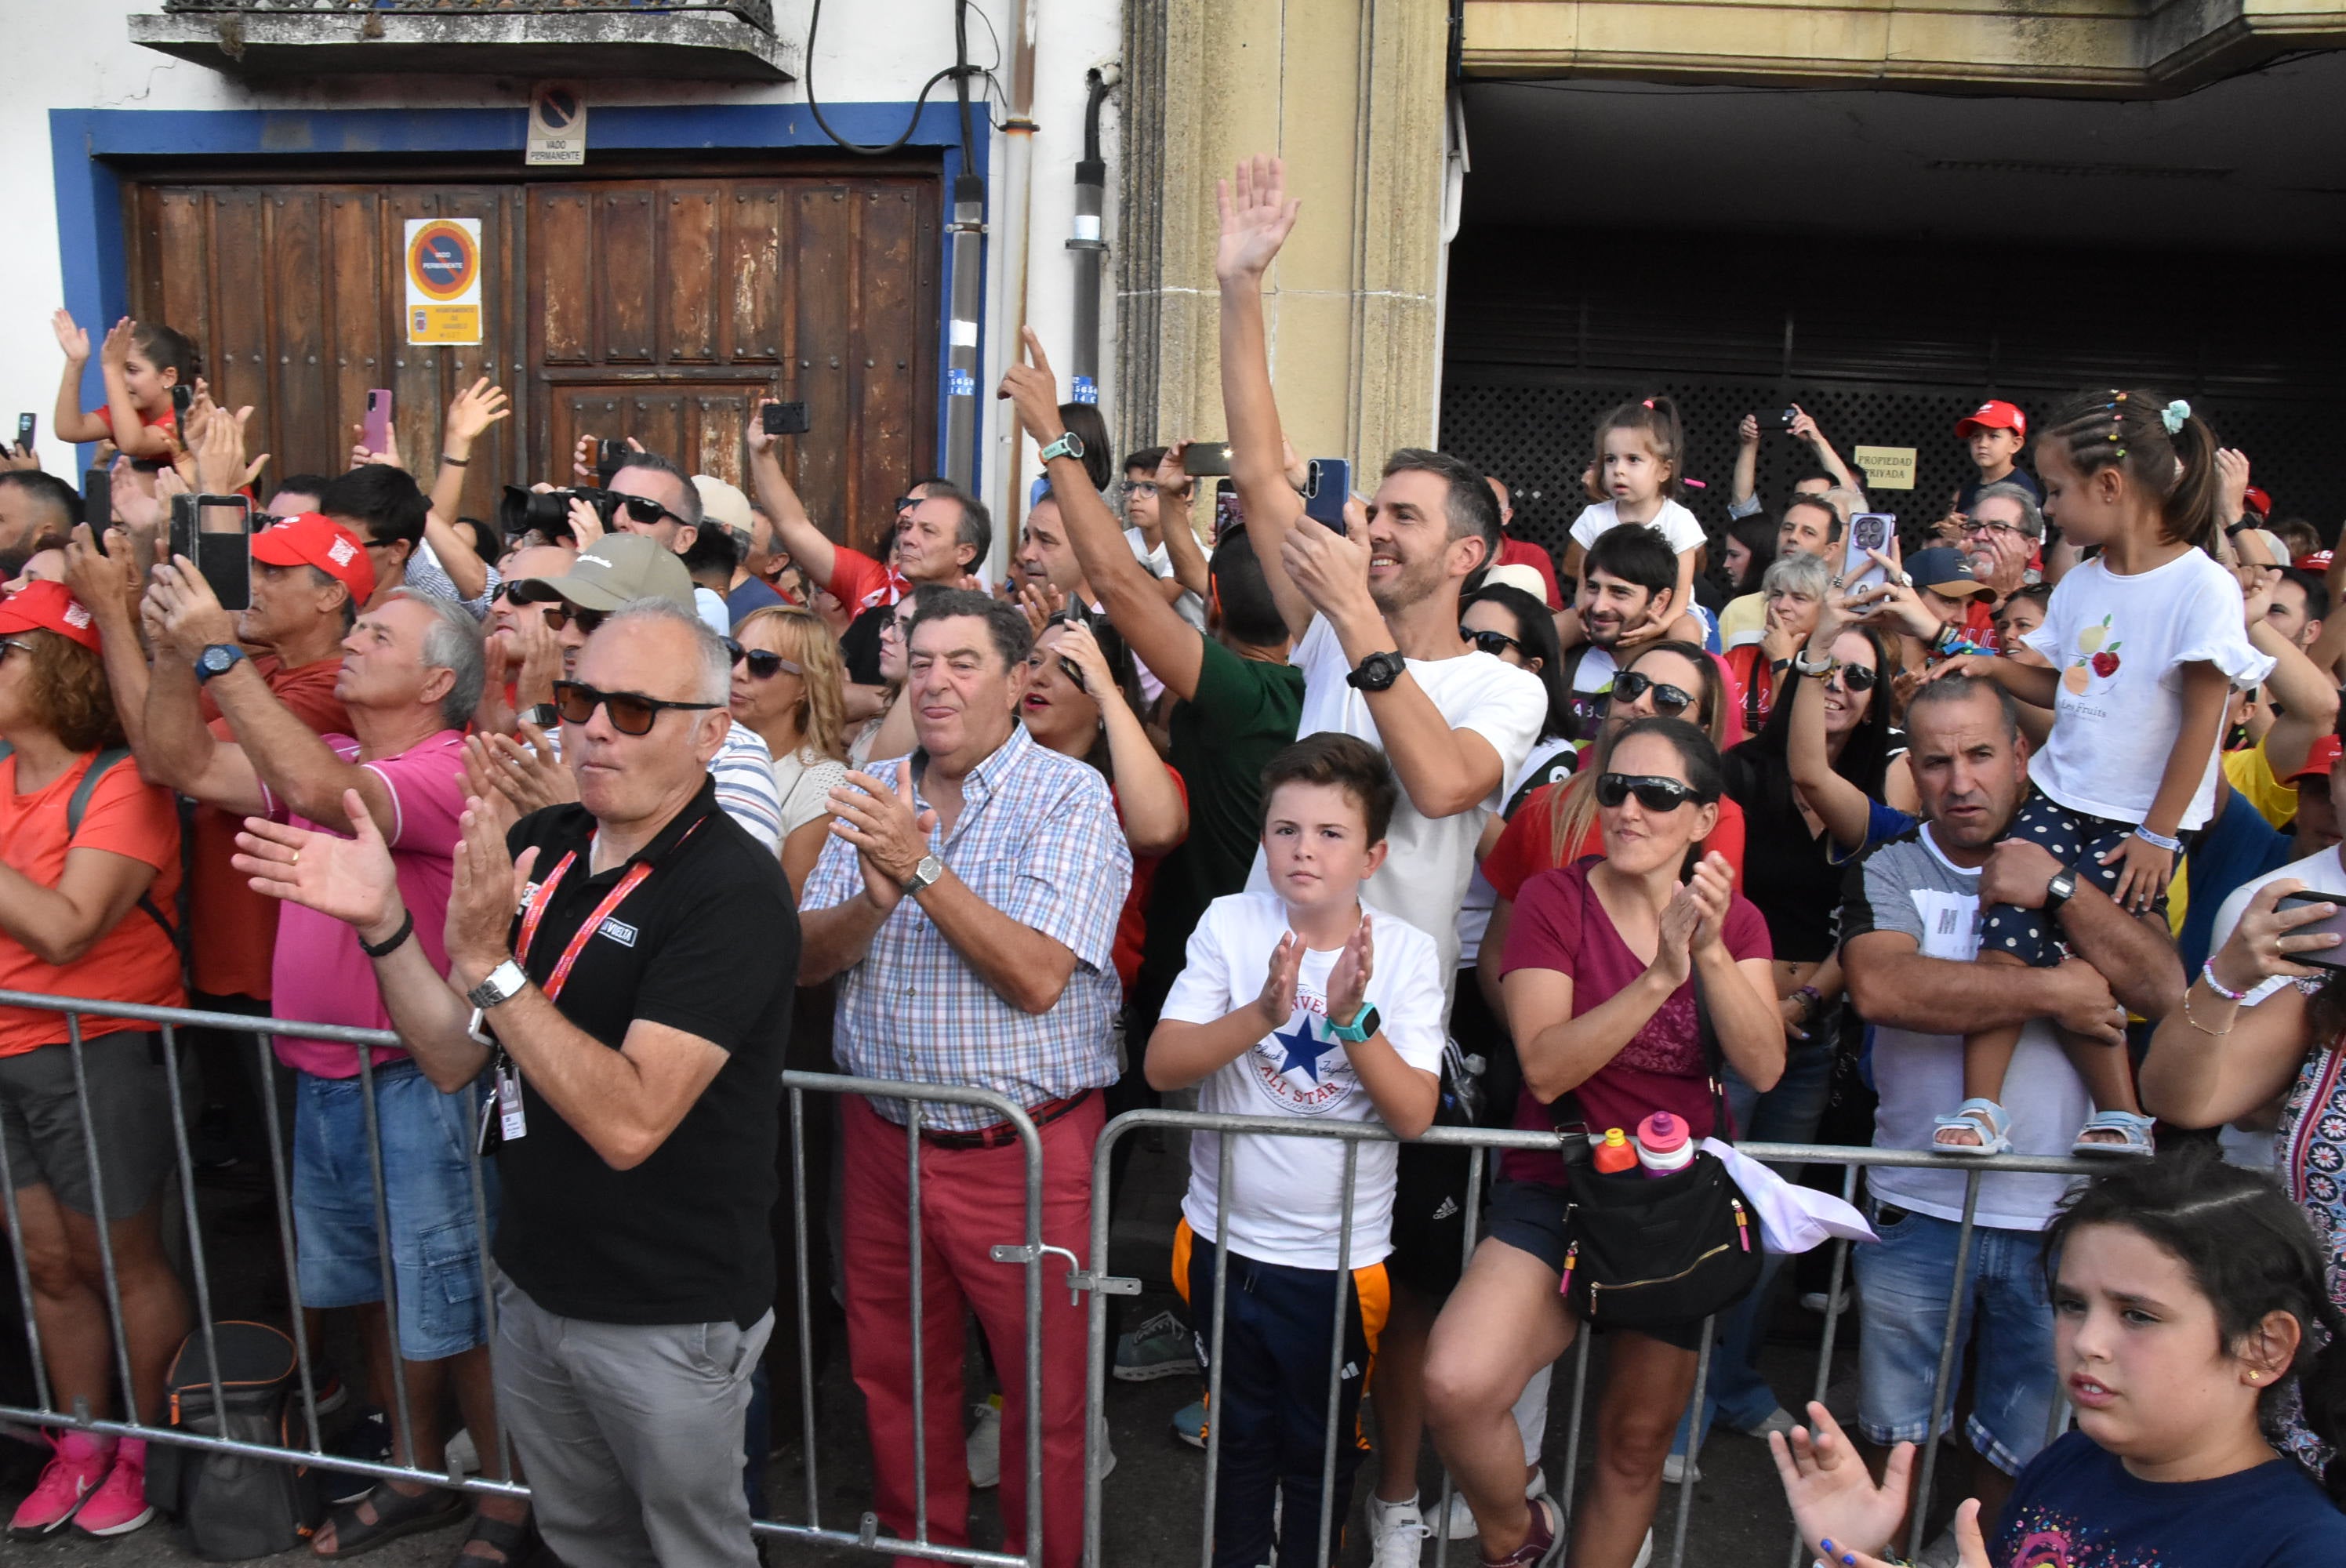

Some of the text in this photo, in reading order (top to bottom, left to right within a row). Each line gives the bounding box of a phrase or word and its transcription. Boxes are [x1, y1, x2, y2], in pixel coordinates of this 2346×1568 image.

[546, 140, 566, 149] VADO
[531, 151, 580, 160] PERMANENTE
[1858, 456, 1912, 466] PROPIEDAD
[2075, 702, 2108, 717] Fruits
[1261, 1065, 1341, 1105] ALL STAR
